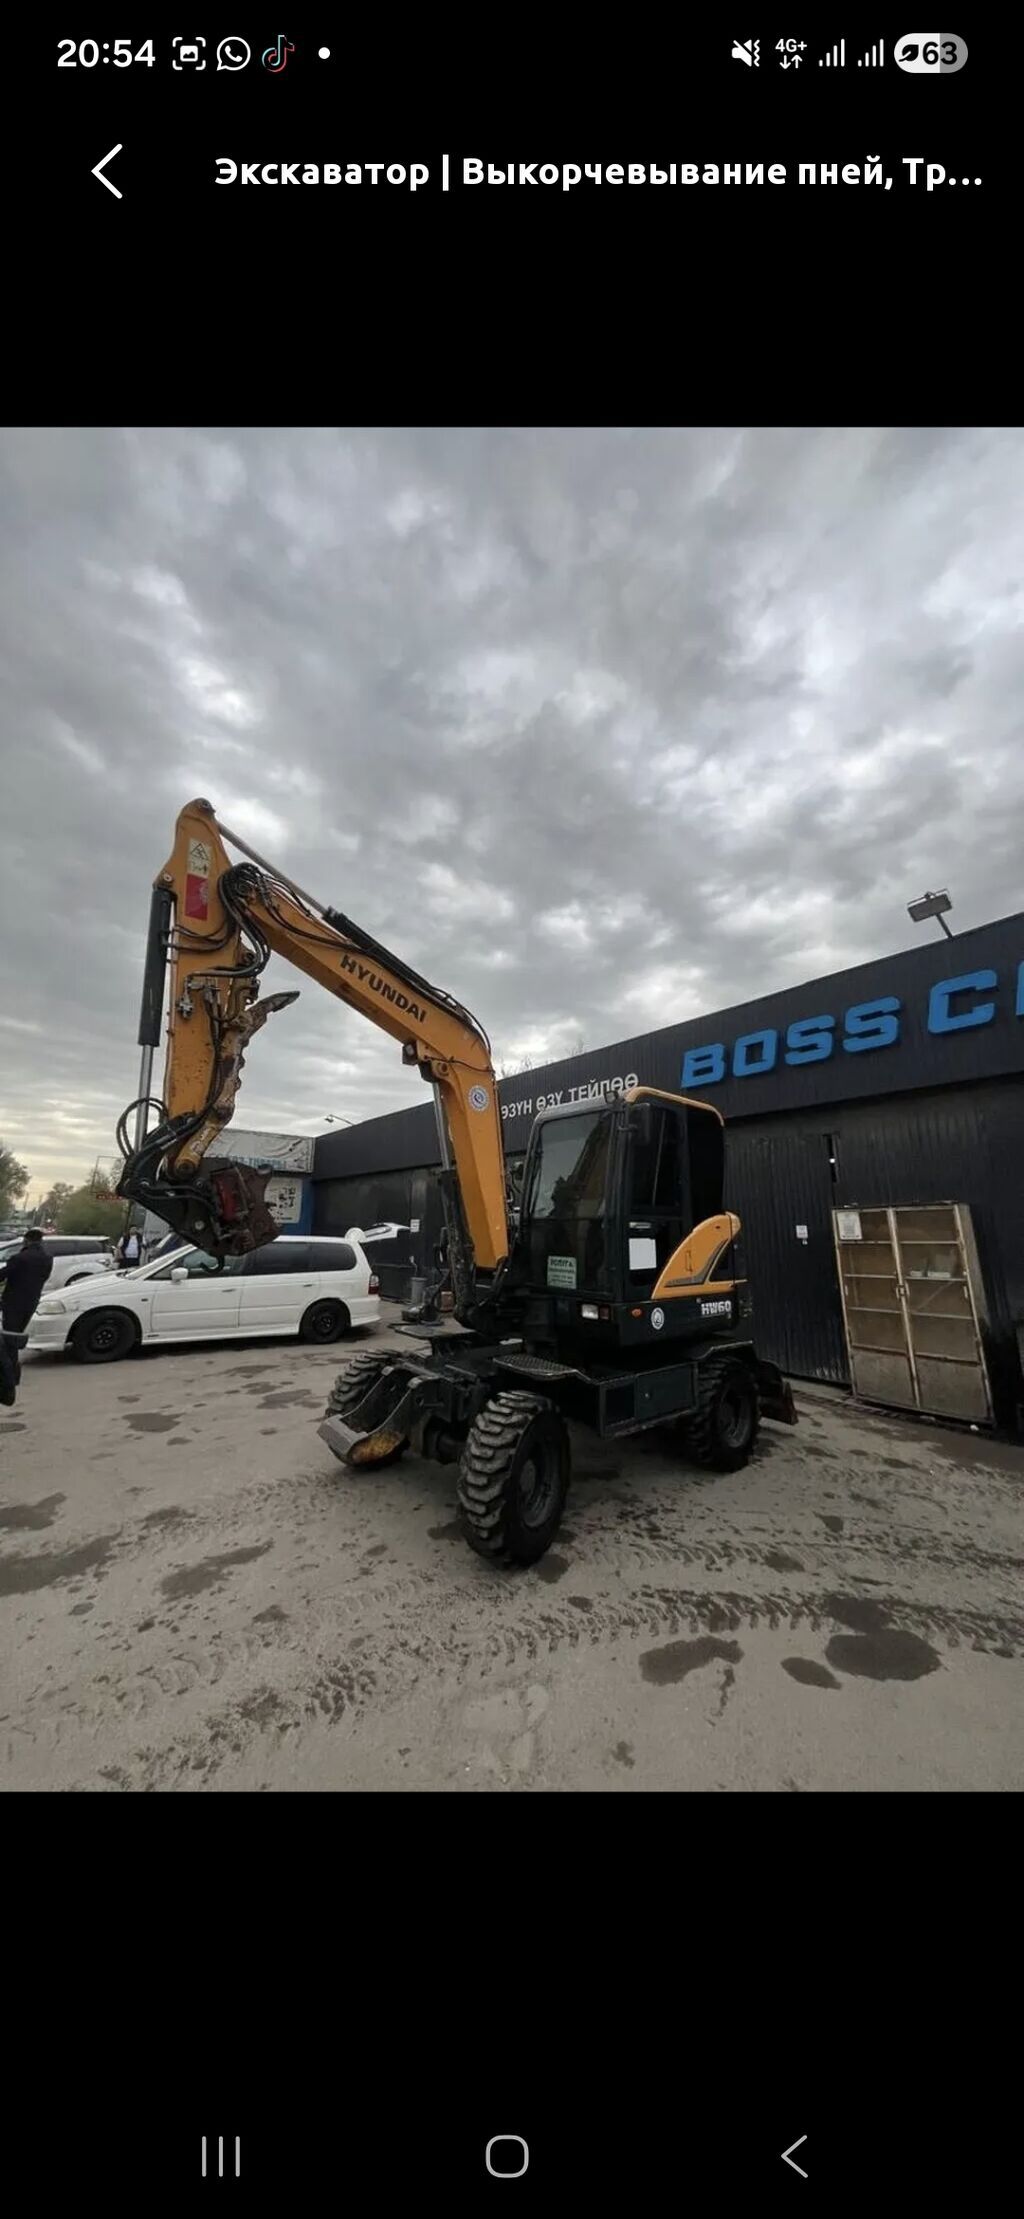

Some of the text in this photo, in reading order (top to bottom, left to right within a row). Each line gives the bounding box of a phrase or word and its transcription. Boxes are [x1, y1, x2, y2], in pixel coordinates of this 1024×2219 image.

[341, 954, 426, 1022] HYUNDAI
[681, 960, 1024, 1088] BOSS C
